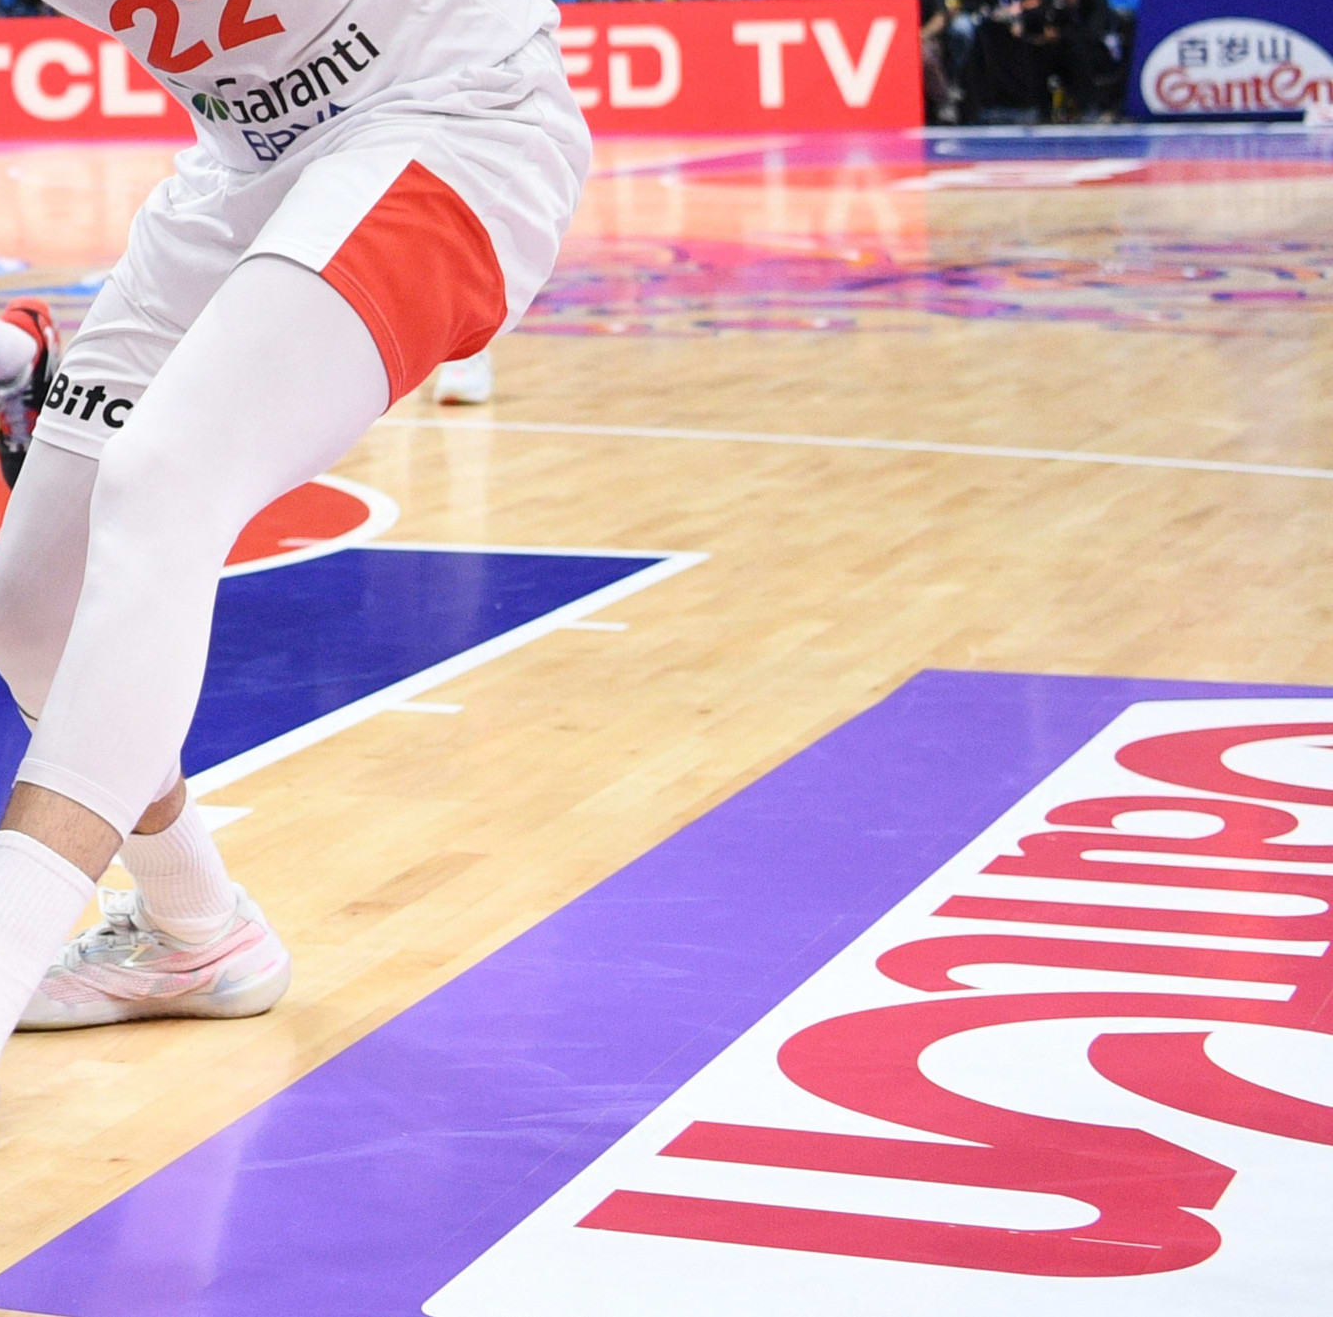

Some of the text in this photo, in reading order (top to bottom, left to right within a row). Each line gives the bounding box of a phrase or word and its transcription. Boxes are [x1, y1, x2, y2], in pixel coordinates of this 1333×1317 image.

[215, 22, 381, 125] Garanti
[733, 17, 897, 108] TV
[44, 372, 135, 429] Bitc
